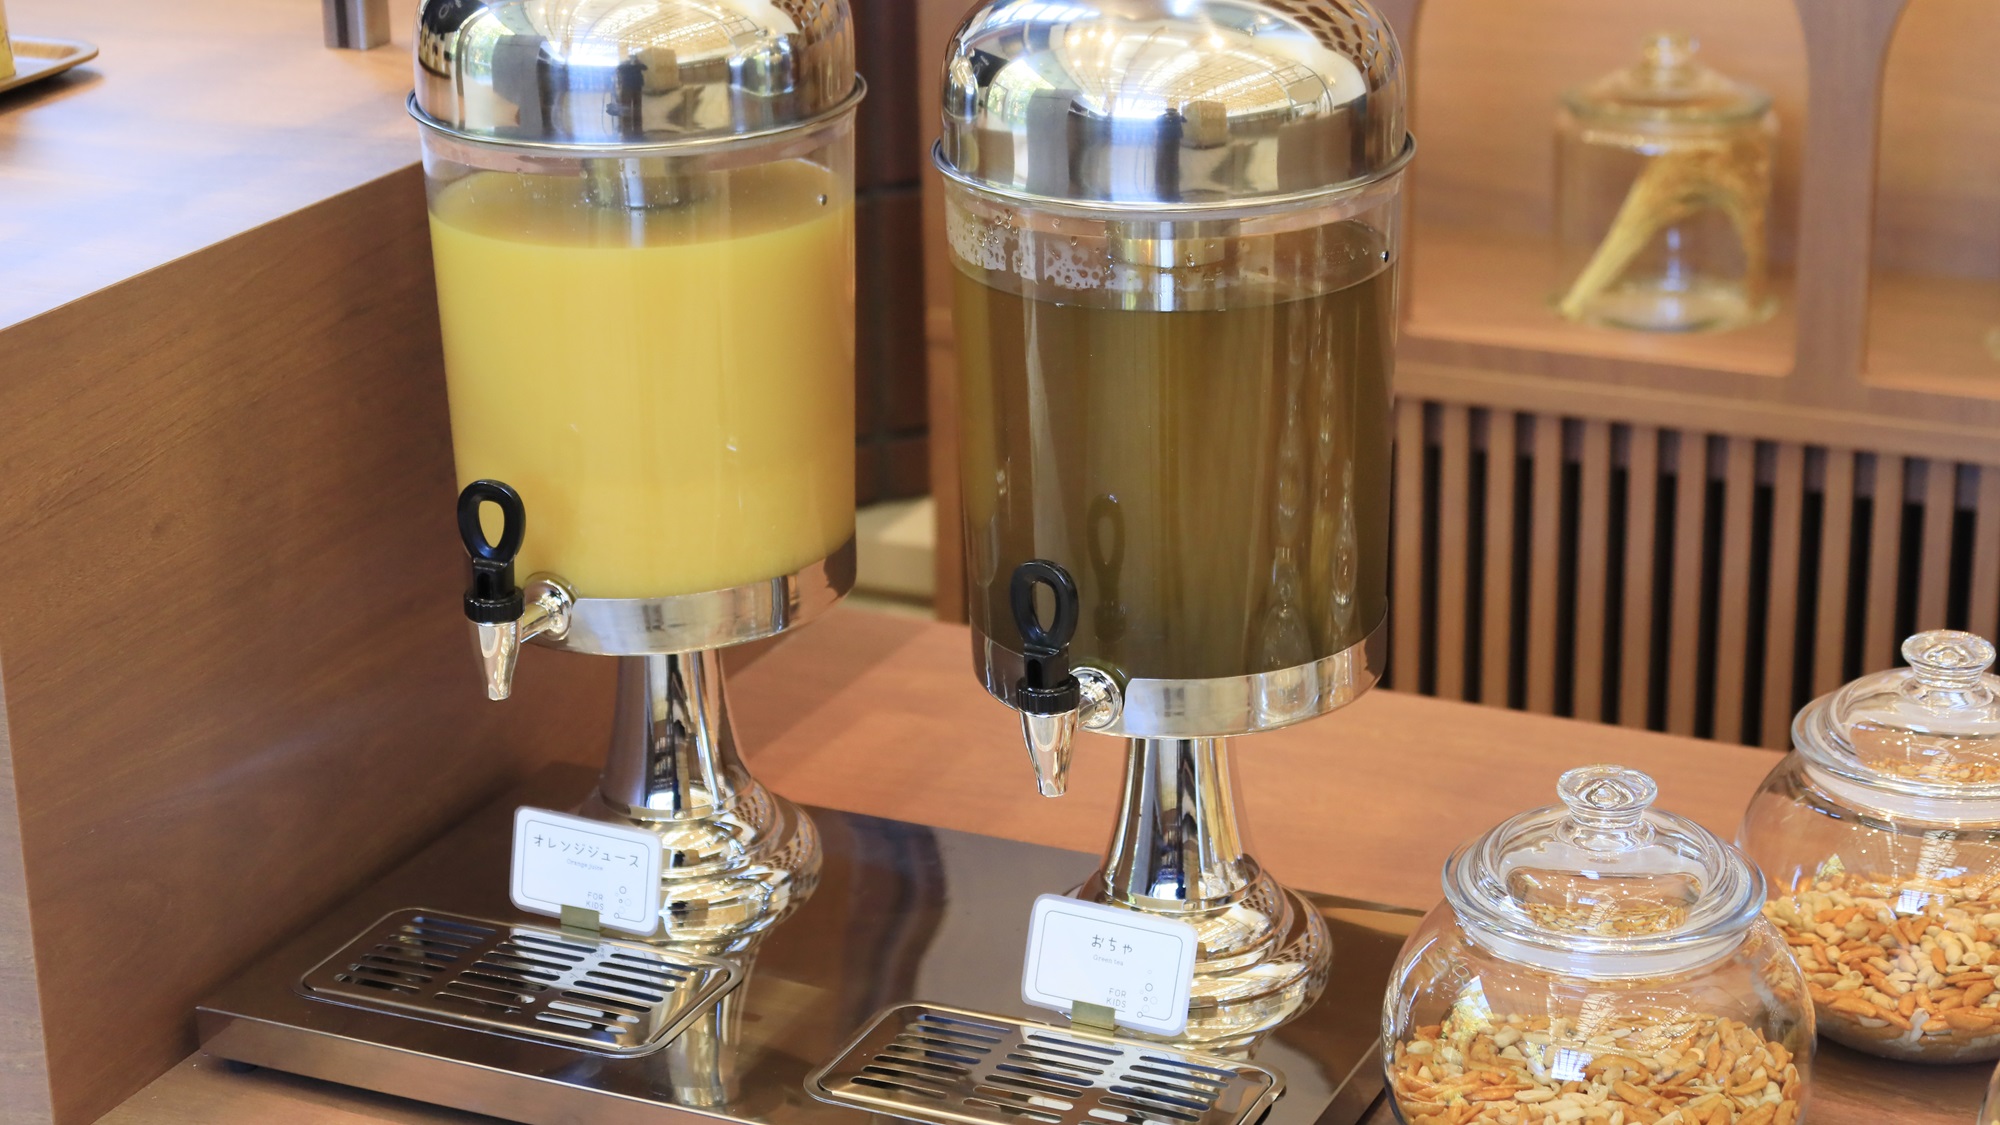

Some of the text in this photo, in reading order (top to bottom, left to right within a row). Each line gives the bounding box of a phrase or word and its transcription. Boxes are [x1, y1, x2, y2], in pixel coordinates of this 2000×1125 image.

[533, 834, 639, 868] オレンジジュース
[587, 891, 603, 901] FOR
[586, 901, 604, 911] KIDS
[1091, 934, 1133, 954] おちゃ
[1093, 954, 1124, 966] Green tea
[1109, 987, 1127, 998] FOR
[1106, 997, 1127, 1008] KIDS
